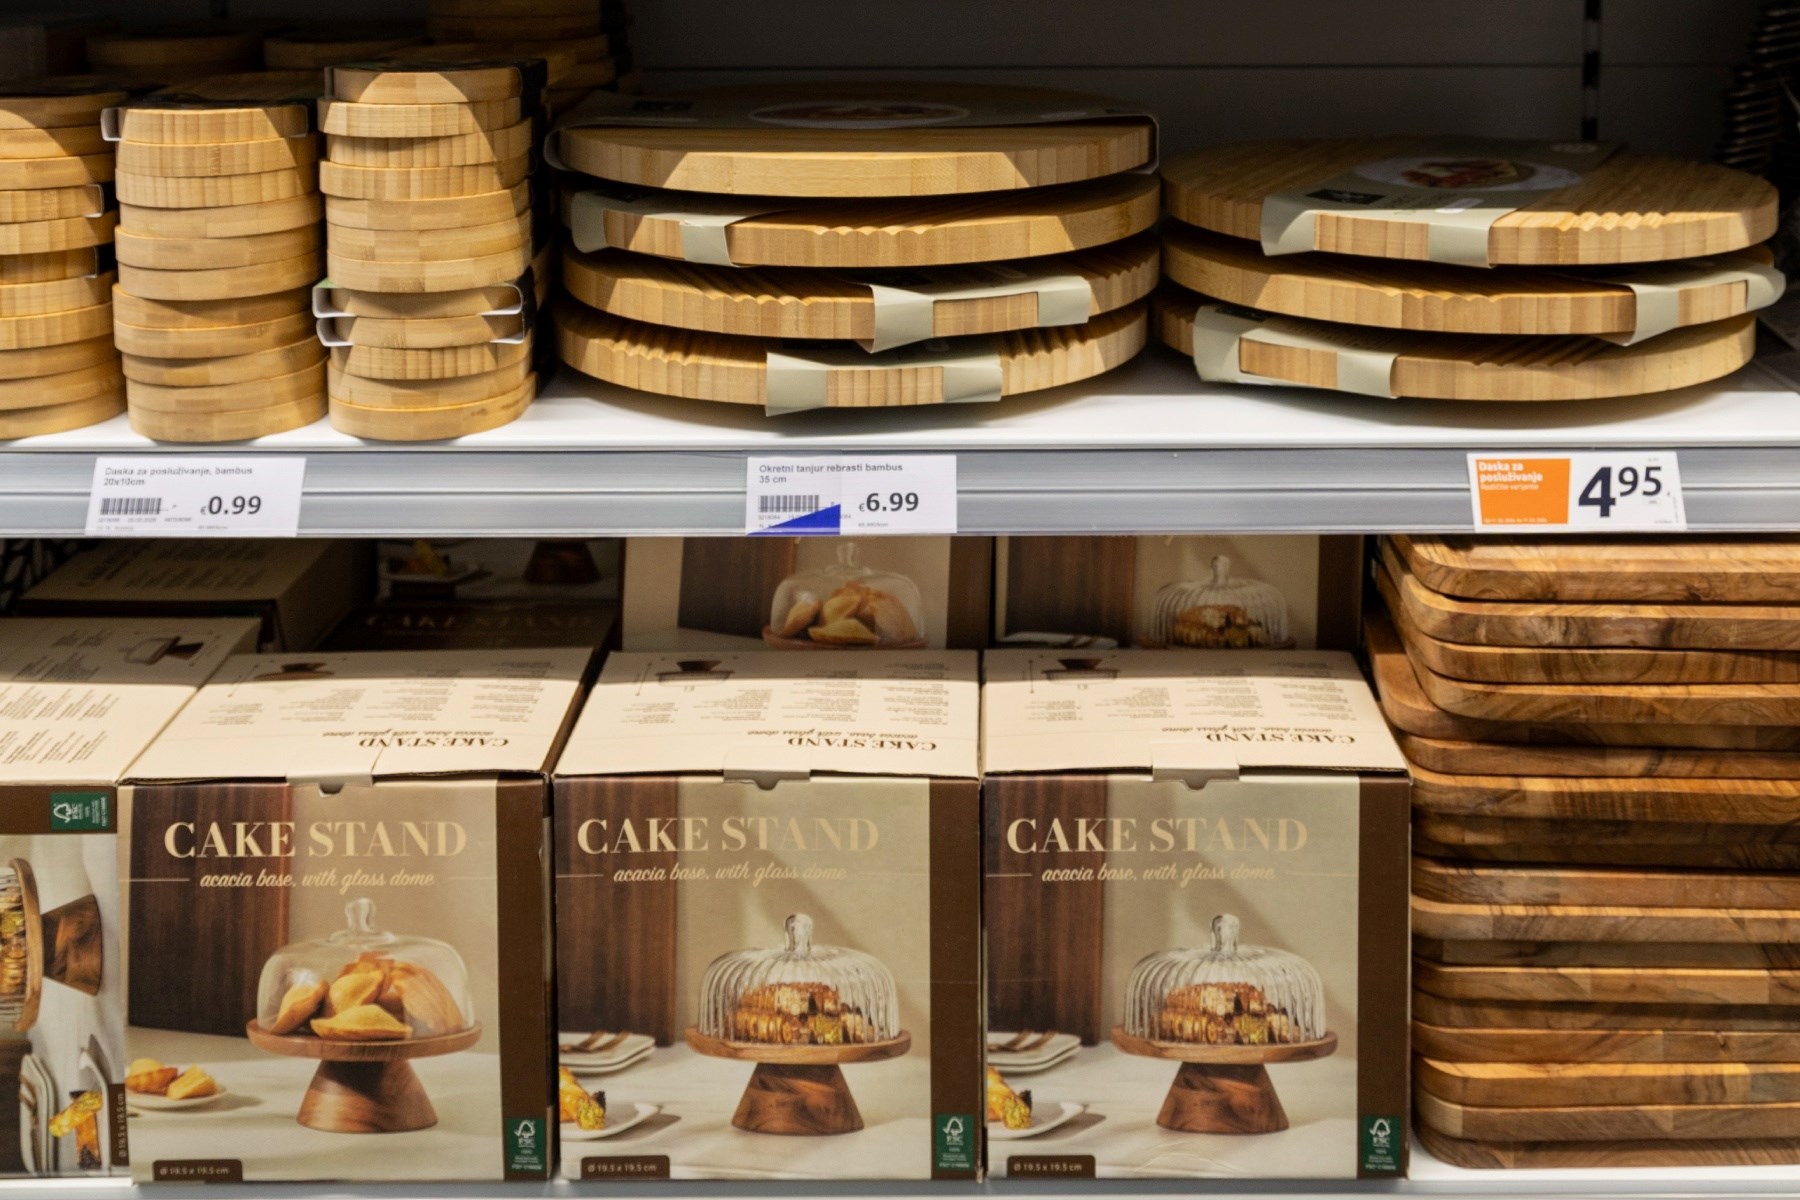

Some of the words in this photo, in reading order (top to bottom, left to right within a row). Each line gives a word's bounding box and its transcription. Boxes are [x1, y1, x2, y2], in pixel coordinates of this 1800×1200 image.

[215, 467, 253, 475] bambus
[759, 464, 794, 473] Okretni
[797, 464, 824, 475] tanjur
[826, 463, 863, 473] rebrasti
[865, 463, 903, 472] bambus
[1479, 461, 1509, 471] Daska
[1512, 463, 1523, 471] za
[759, 475, 770, 483] 35
[1479, 471, 1543, 483] posluživanje
[359, 737, 440, 747] STAND
[443, 738, 509, 748] CAKE
[788, 737, 866, 747] STAND
[1206, 733, 1285, 742] STAND
[1291, 734, 1355, 744] CAKE
[873, 740, 937, 751] CAKE
[164, 821, 296, 859] CAKE
[308, 821, 467, 857] STAND
[577, 818, 708, 854] CAKE
[721, 817, 879, 852] STAND
[1006, 818, 1137, 854] CAKE
[1150, 817, 1308, 852] STAND
[613, 866, 666, 882] acacia
[714, 861, 750, 880] with
[752, 862, 799, 887] glass
[801, 862, 848, 880] dome
[1041, 865, 1095, 882] acacia
[1143, 863, 1178, 880] with
[1180, 864, 1225, 889] glass
[1229, 863, 1275, 880] dome
[200, 869, 254, 887] acacia
[301, 868, 339, 887] with
[339, 869, 387, 895] glass
[389, 868, 435, 887] dome
